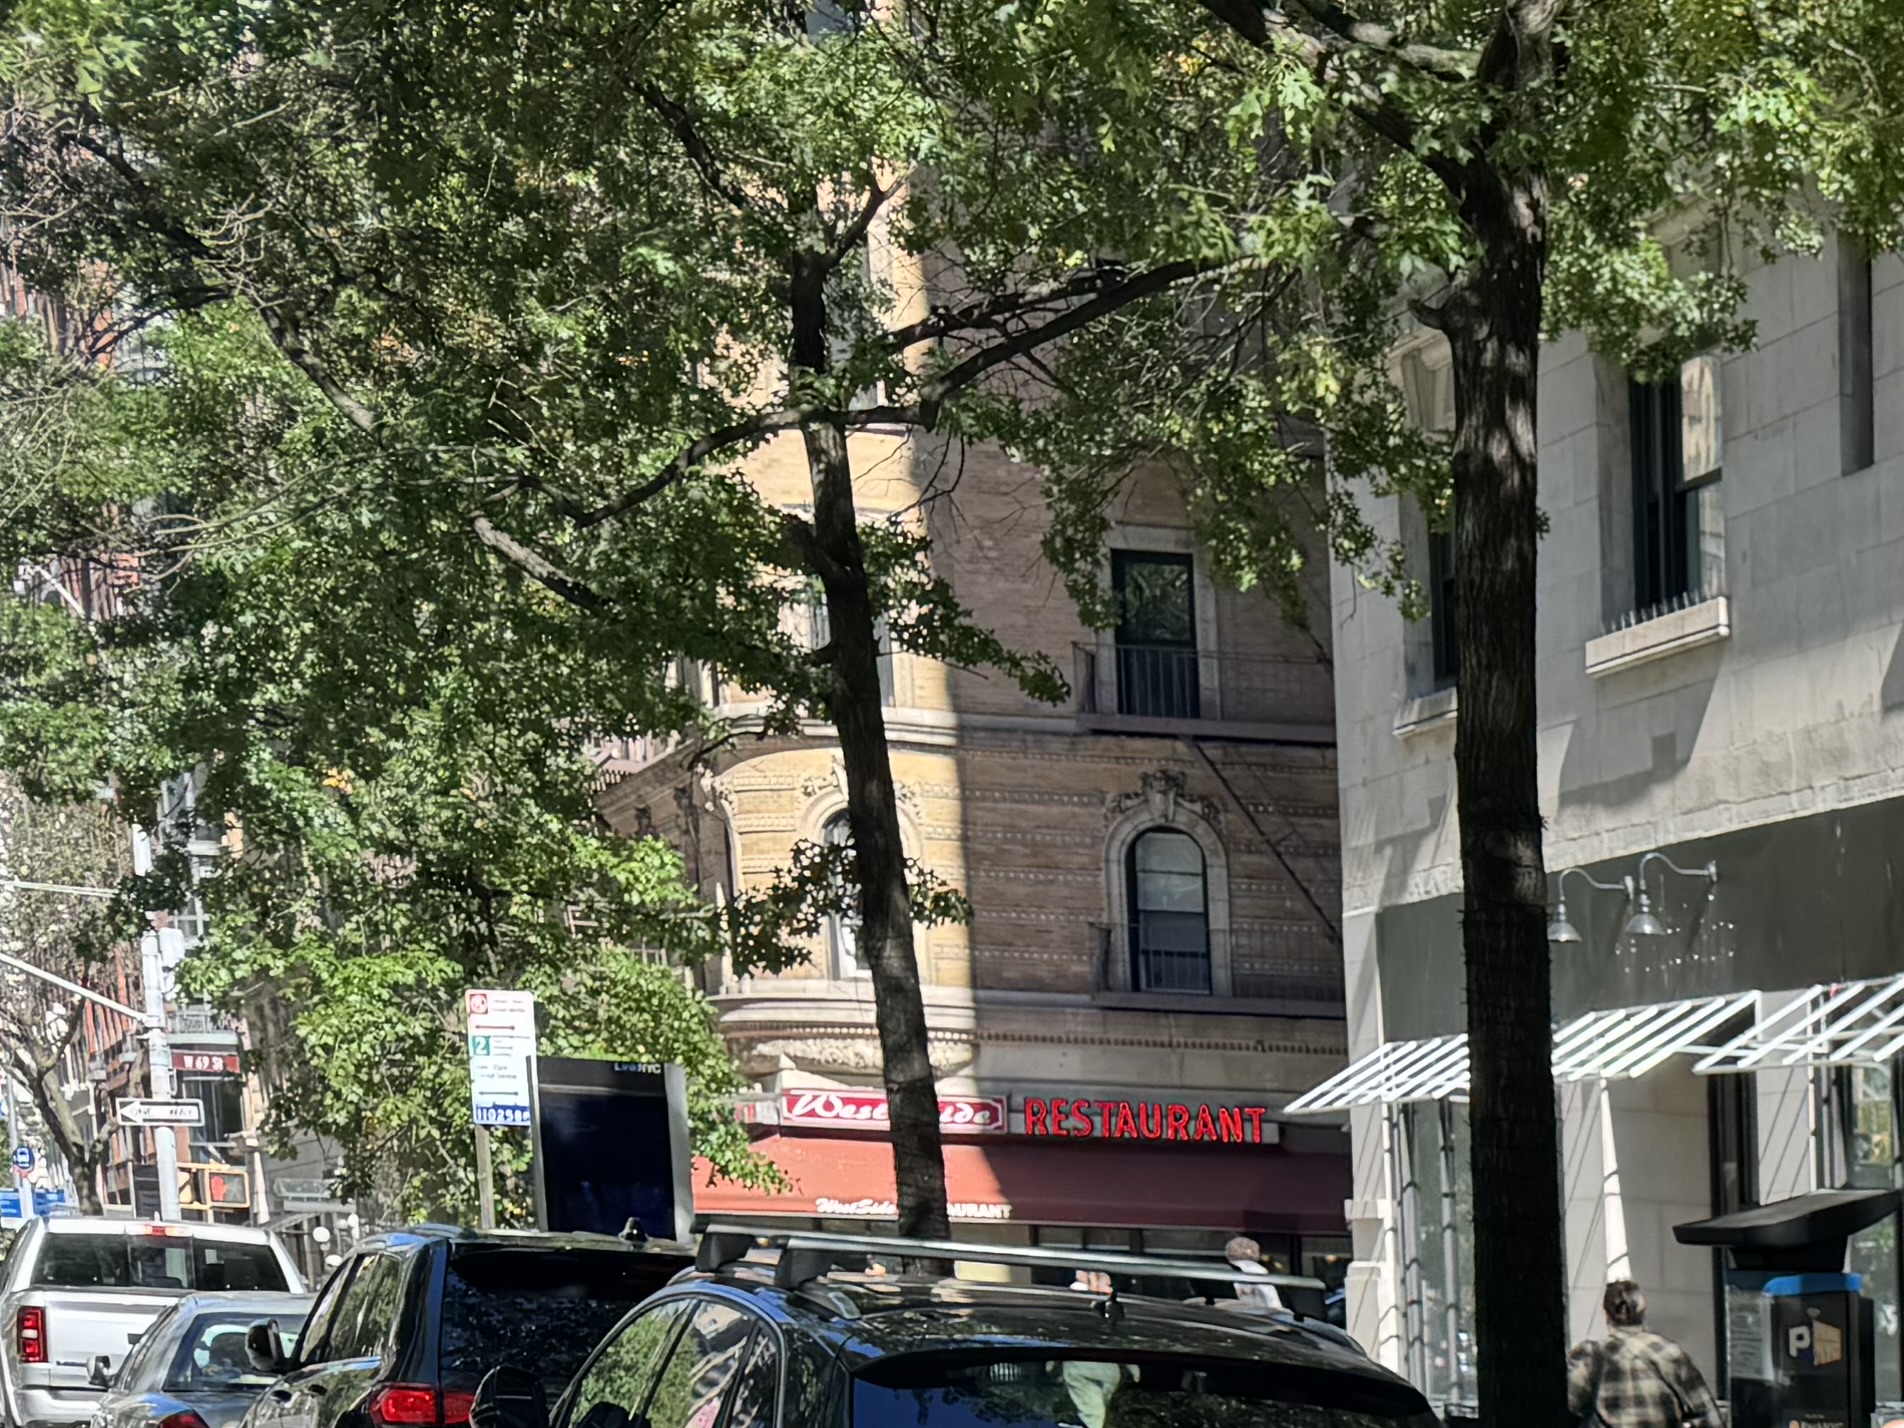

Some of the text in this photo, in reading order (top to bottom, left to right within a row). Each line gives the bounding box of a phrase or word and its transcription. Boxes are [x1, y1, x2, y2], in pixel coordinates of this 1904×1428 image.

[183, 1055, 194, 1069] W
[790, 1091, 889, 1120] West
[1023, 1097, 1267, 1144] RESTAURANT
[1788, 1325, 1811, 1358] P
